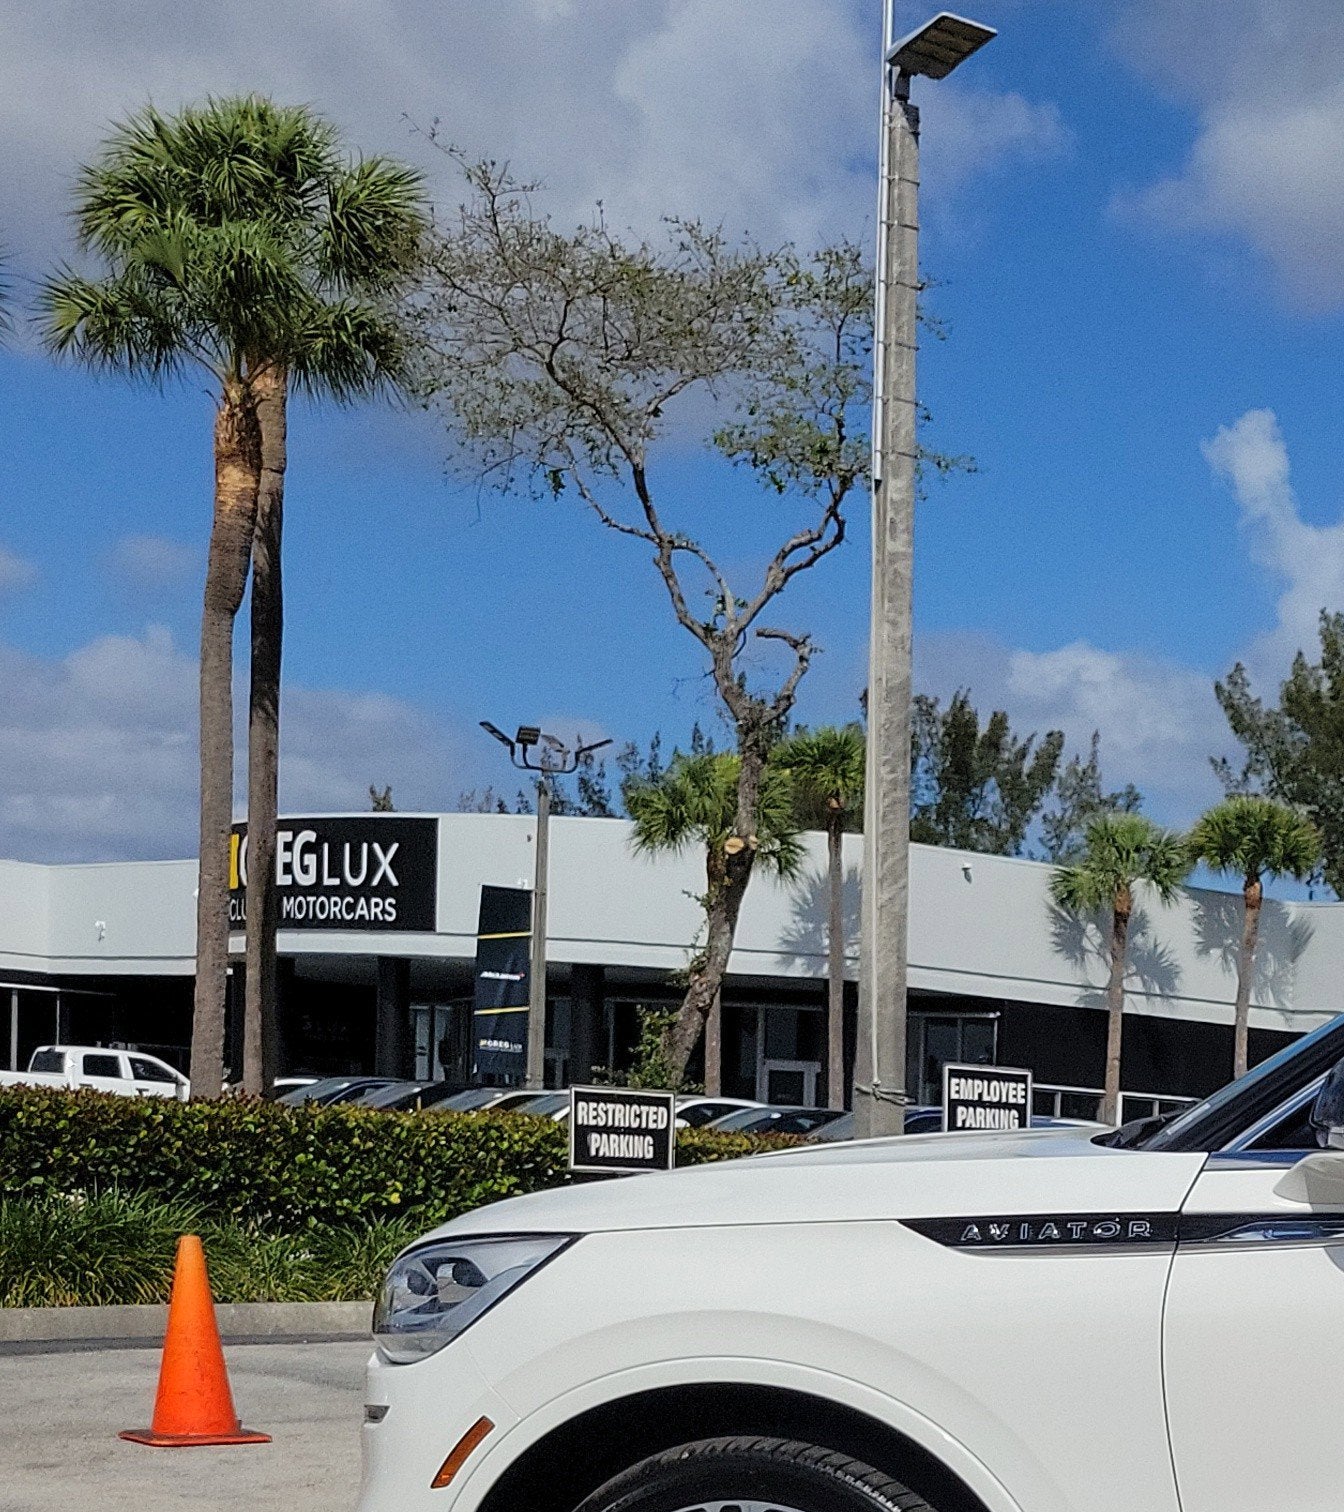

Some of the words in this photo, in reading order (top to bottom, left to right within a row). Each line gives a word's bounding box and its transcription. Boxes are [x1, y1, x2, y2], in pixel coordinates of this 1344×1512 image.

[282, 896, 397, 922] MOTORCARS
[950, 1077, 1026, 1104] EMPLOYEE
[577, 1101, 668, 1129] RESTRICTED
[956, 1106, 1019, 1130] PARKING
[590, 1132, 654, 1159] PARKING
[960, 1220, 1153, 1241] AVIATOR
